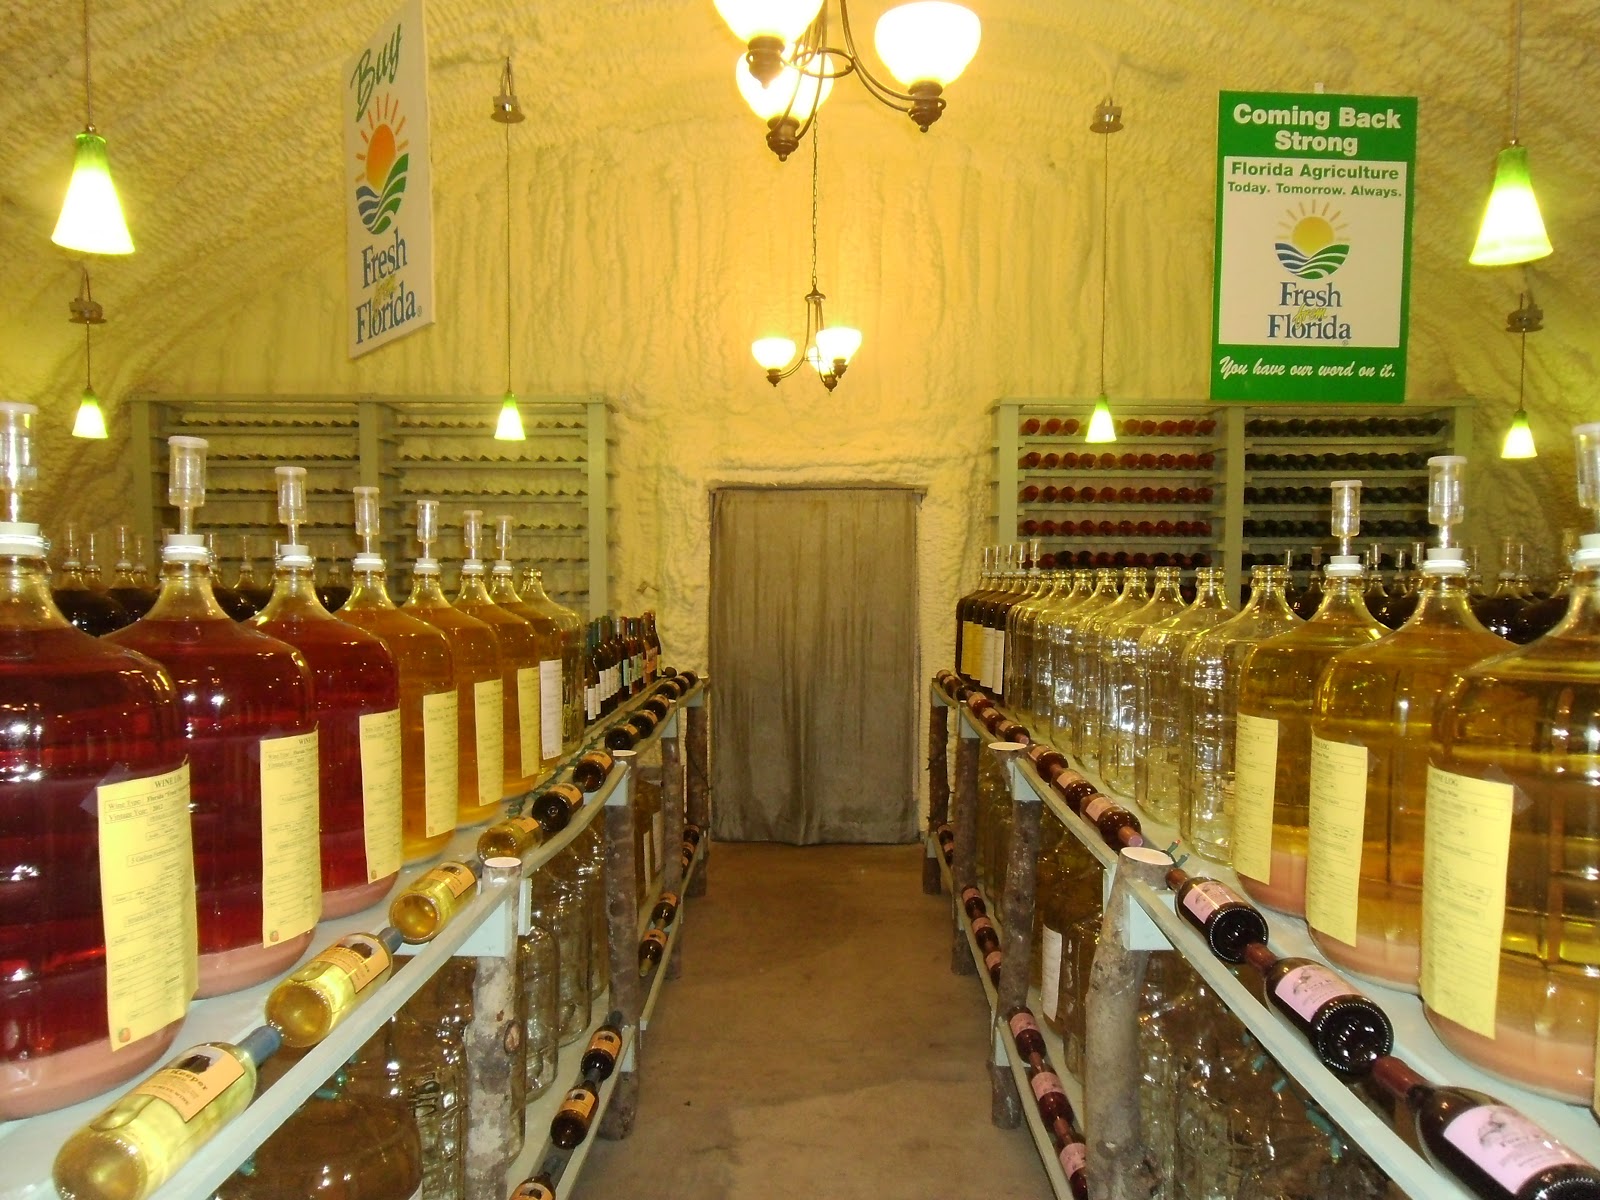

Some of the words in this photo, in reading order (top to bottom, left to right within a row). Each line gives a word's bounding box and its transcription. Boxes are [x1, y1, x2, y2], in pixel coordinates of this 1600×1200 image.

[350, 23, 401, 122] Buy
[1233, 103, 1330, 130] Coming
[1339, 107, 1401, 129] Back
[1275, 130, 1358, 156] Strong
[1231, 161, 1294, 178] Florida
[1300, 164, 1400, 180] Agriculture
[1227, 181, 1271, 195] Today.
[1276, 183, 1346, 196] Tomorrow.
[1351, 185, 1402, 197] Always.
[362, 227, 408, 289] Fresh
[1279, 282, 1342, 307] Fresh
[356, 280, 416, 344] Florida
[1267, 314, 1352, 340] Florida
[1219, 355, 1248, 380] You
[1253, 358, 1286, 376] have
[1290, 364, 1313, 376] our
[1318, 361, 1355, 377] word
[1358, 366, 1375, 377] on
[1380, 364, 1396, 378] it.
[171, 1069, 208, 1091] Keeper
